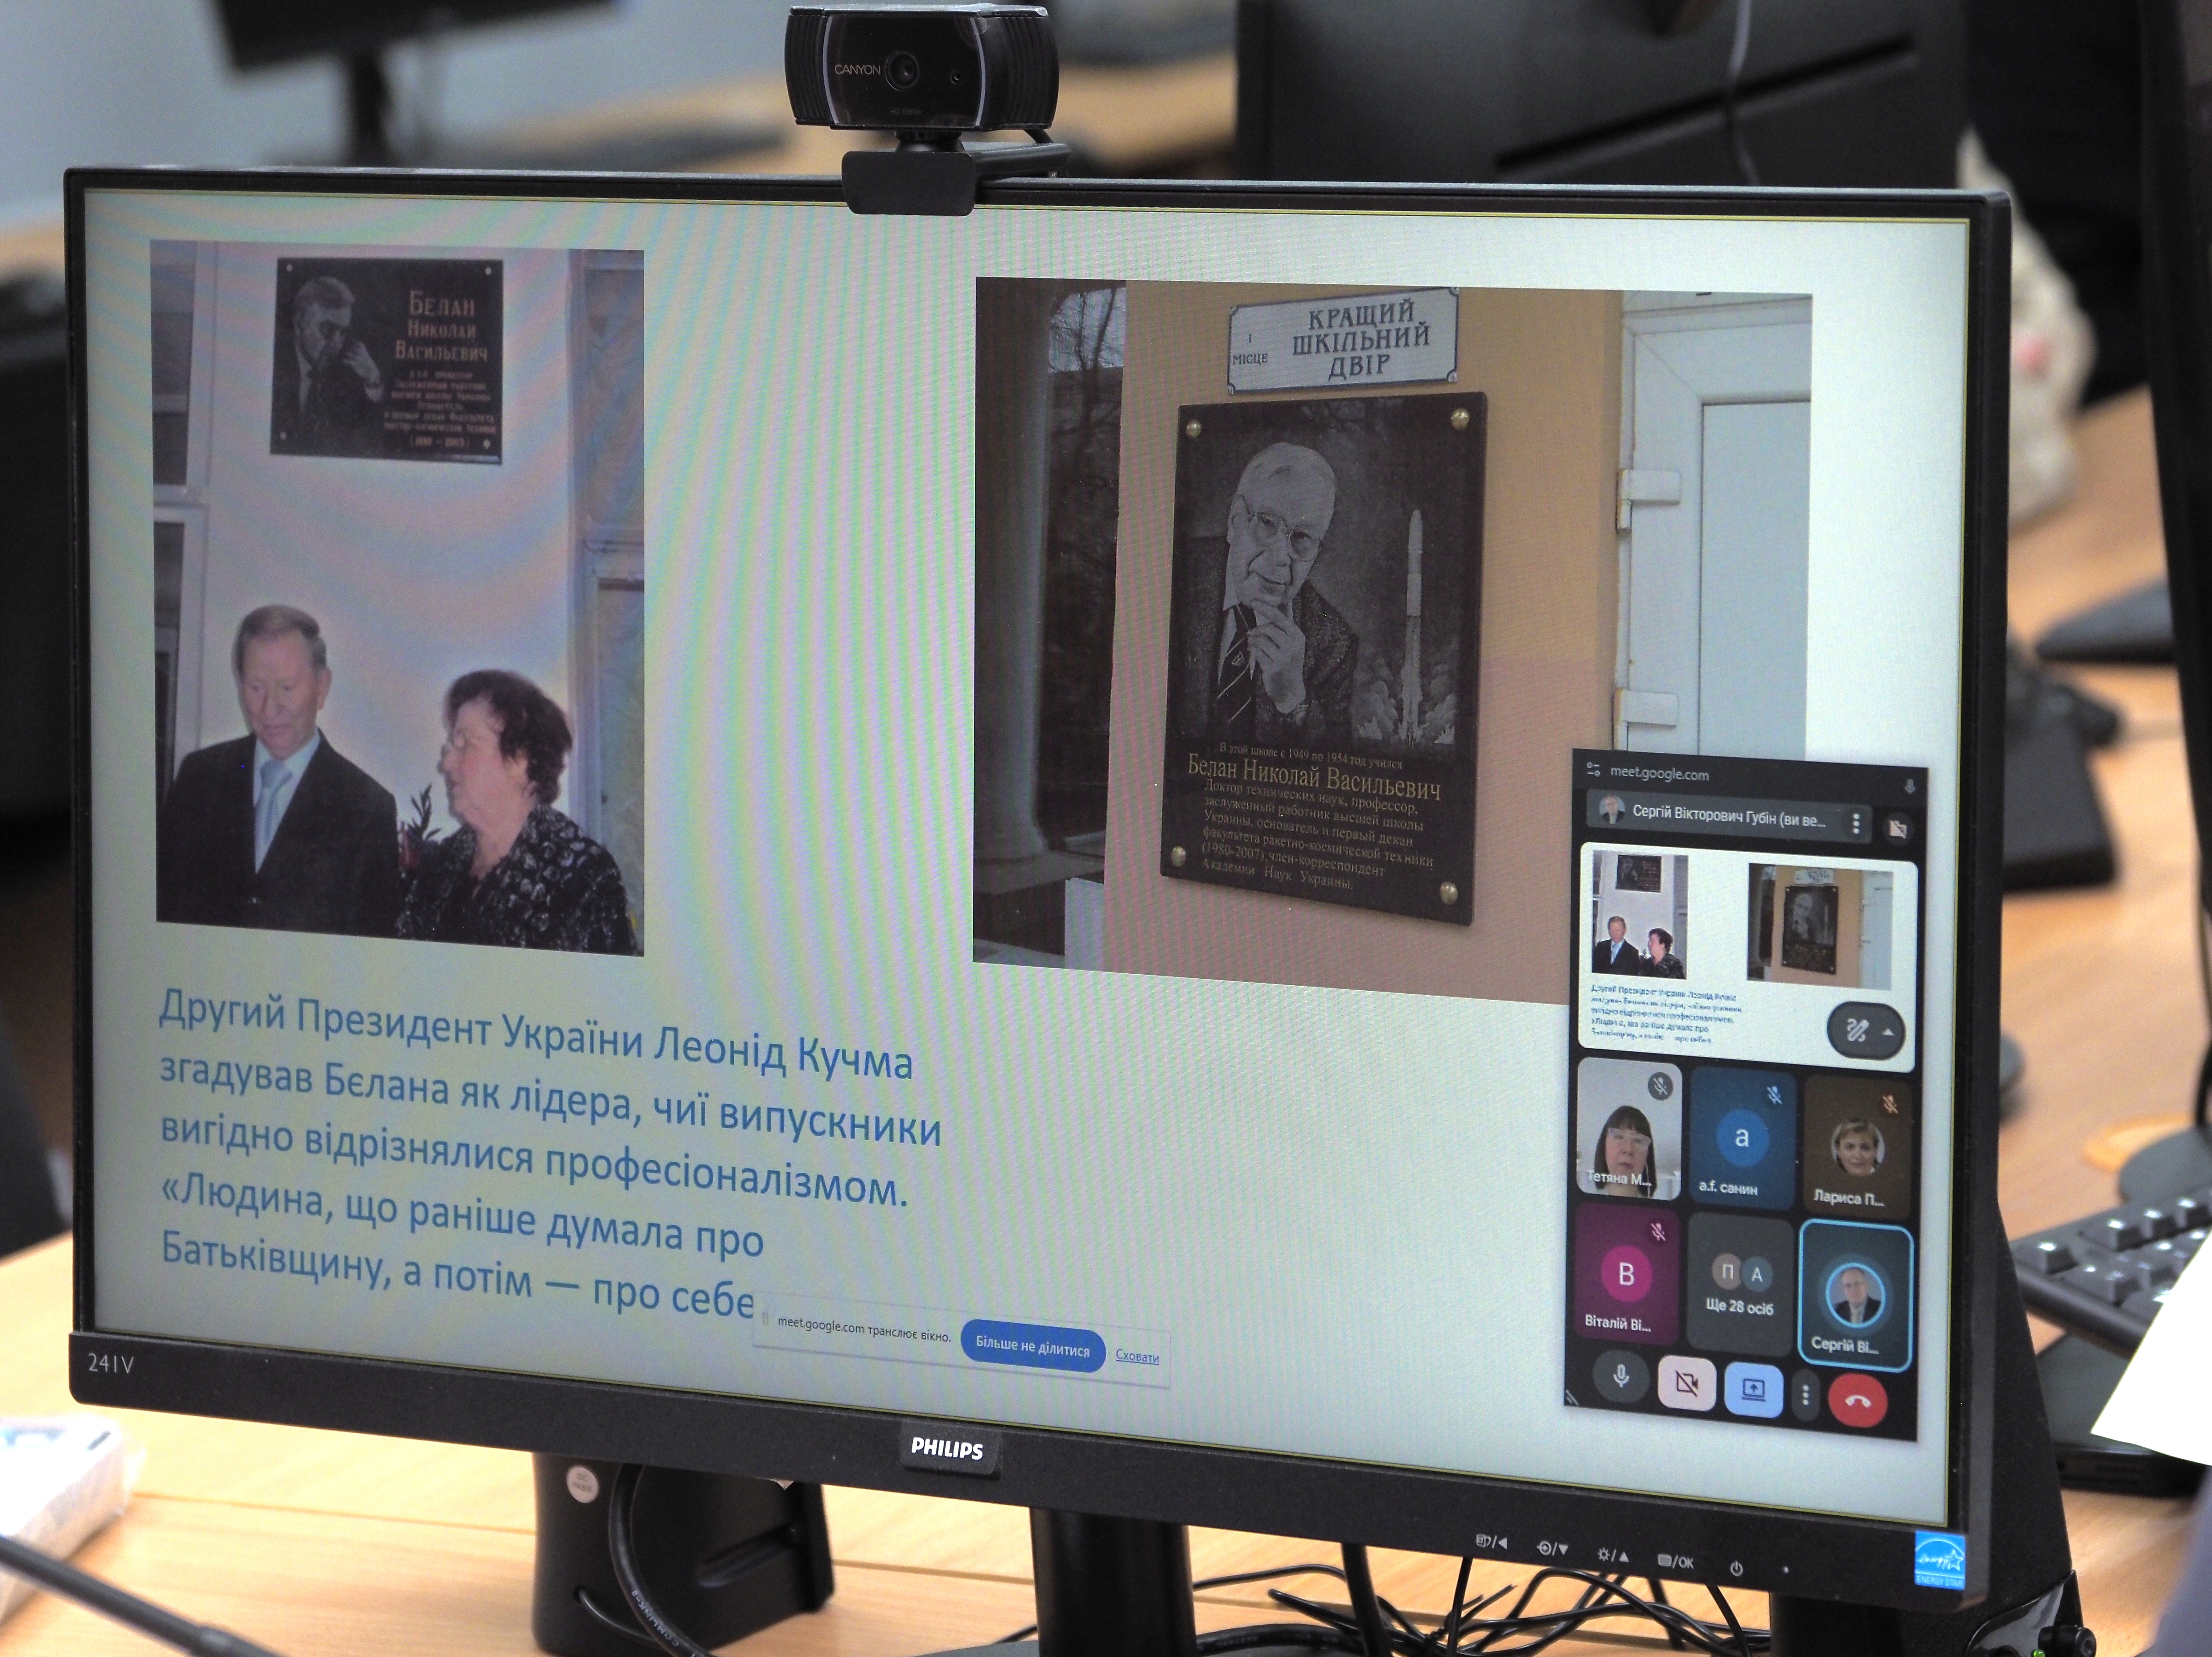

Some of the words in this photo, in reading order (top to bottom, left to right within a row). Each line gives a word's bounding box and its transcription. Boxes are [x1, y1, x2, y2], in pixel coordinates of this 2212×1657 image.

[835, 64, 881, 75] CANYON
[1308, 298, 1414, 330] КРАЩИЙ
[1293, 321, 1431, 355] ШКІЛЬНИЙ
[1233, 353, 1269, 365] МІСЦЕ
[1328, 354, 1390, 381] ДВІР
[1220, 742, 1226, 751] В
[1188, 752, 1237, 779] Белан
[1243, 758, 1320, 787] Николай
[1327, 767, 1441, 801] Васильевич
[1610, 767, 1710, 783] meet.google.com
[1205, 779, 1243, 795] Доктор
[1247, 787, 1315, 801] технических
[1352, 797, 1418, 816] профессор,
[1279, 804, 1330, 820] работник
[1383, 818, 1424, 832] школы
[1633, 804, 1672, 819] Сергій
[1675, 807, 1743, 822] Вікторович
[1746, 811, 1776, 825] Губін
[1780, 812, 1799, 828] (ви
[1203, 826, 1260, 843] факультета
[1257, 819, 1319, 834] основатель
[1322, 828, 1329, 836] и
[1332, 828, 1375, 842] первый
[1379, 834, 1413, 847] декан
[159, 988, 285, 1032] Другий
[298, 998, 492, 1049] Президент
[502, 1013, 643, 1060] України
[654, 1026, 786, 1078] Леонід
[798, 1036, 913, 1082] Кучма
[160, 1058, 313, 1096] згадував
[325, 1062, 448, 1105] Бєлана
[460, 1082, 501, 1110] як
[510, 1078, 642, 1128] лідера,
[653, 1091, 710, 1127] чиї
[720, 1103, 942, 1147] випускники
[161, 1113, 293, 1157] вигідно
[305, 1122, 534, 1174] відрізнялися
[546, 1145, 908, 1208] професіоналізмом.
[1587, 1170, 1628, 1185] Тетяна
[1720, 1183, 1758, 1196] санин
[1814, 1189, 1862, 1206] Лариса
[161, 1172, 334, 1225] «Людина,
[346, 1193, 398, 1229] що
[410, 1198, 536, 1236] раніше
[546, 1212, 682, 1251] думала
[695, 1226, 764, 1263] про
[162, 1230, 391, 1291] Батьківщину,
[403, 1261, 421, 1287] а
[435, 1260, 532, 1297] потім
[593, 1277, 660, 1315] про
[672, 1280, 753, 1319] себе
[1723, 1264, 1734, 1280] П
[1706, 1297, 1727, 1313] Ще
[1729, 1299, 1744, 1313] 28
[1747, 1302, 1774, 1316] осіб
[778, 1315, 865, 1335] meet.google.com
[868, 1325, 918, 1340] транслює
[921, 1329, 952, 1343] вікно.
[1585, 1314, 1627, 1330] Віталій
[976, 1335, 1018, 1352] Більше
[1021, 1340, 1036, 1353] не
[1039, 1340, 1090, 1360] ділитися
[1116, 1348, 1159, 1364] Сховати
[1811, 1336, 1854, 1353] Сергій
[911, 1437, 983, 1460] PHILIPS
